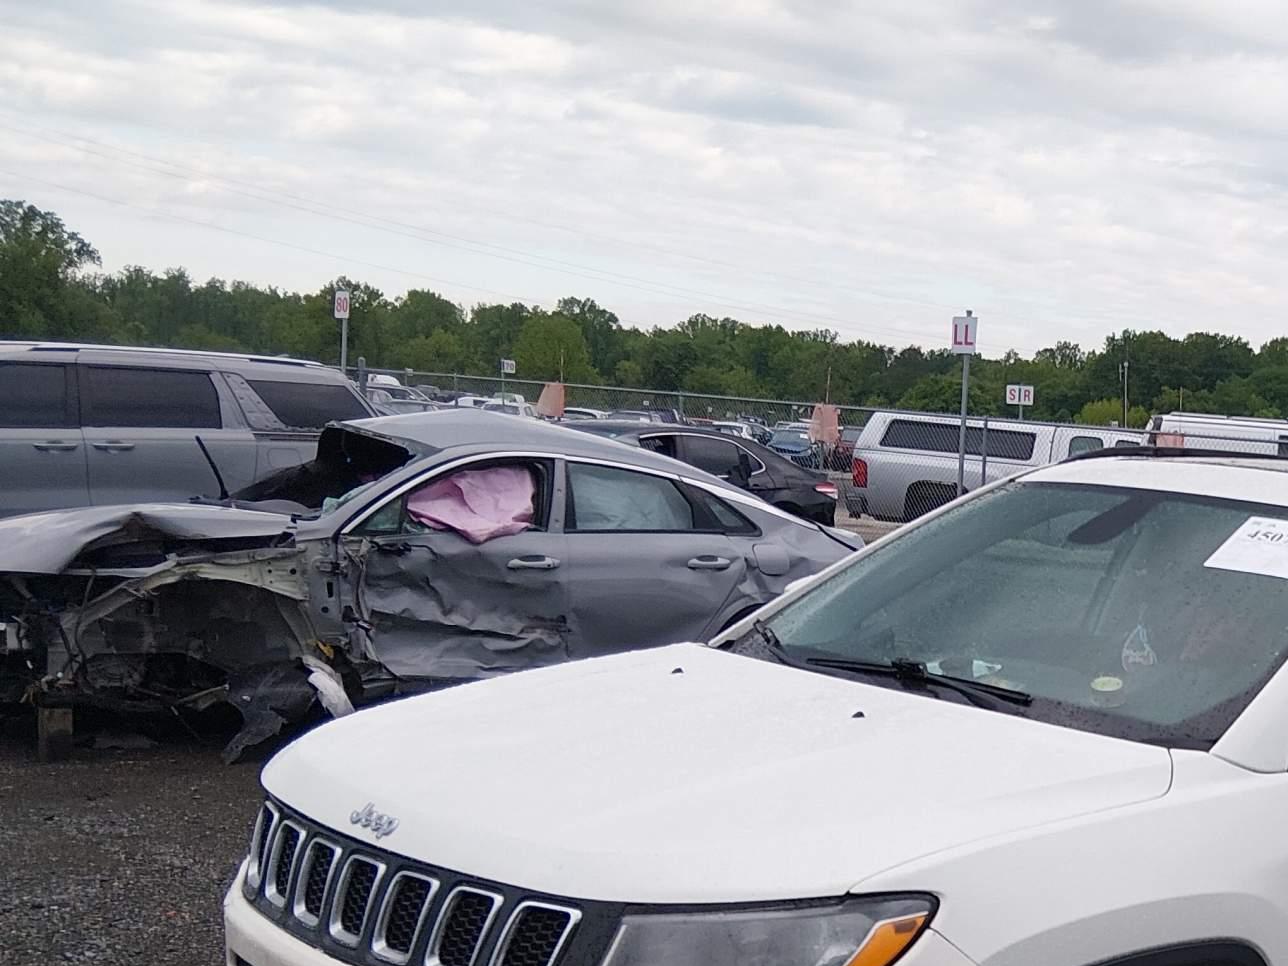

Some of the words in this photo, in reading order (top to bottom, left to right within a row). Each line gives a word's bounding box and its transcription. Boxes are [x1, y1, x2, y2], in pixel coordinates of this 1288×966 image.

[336, 296, 348, 313] 80
[953, 323, 974, 346] LL
[1009, 388, 1016, 401] S
[1023, 389, 1031, 402] R
[350, 801, 400, 840] Jeep
